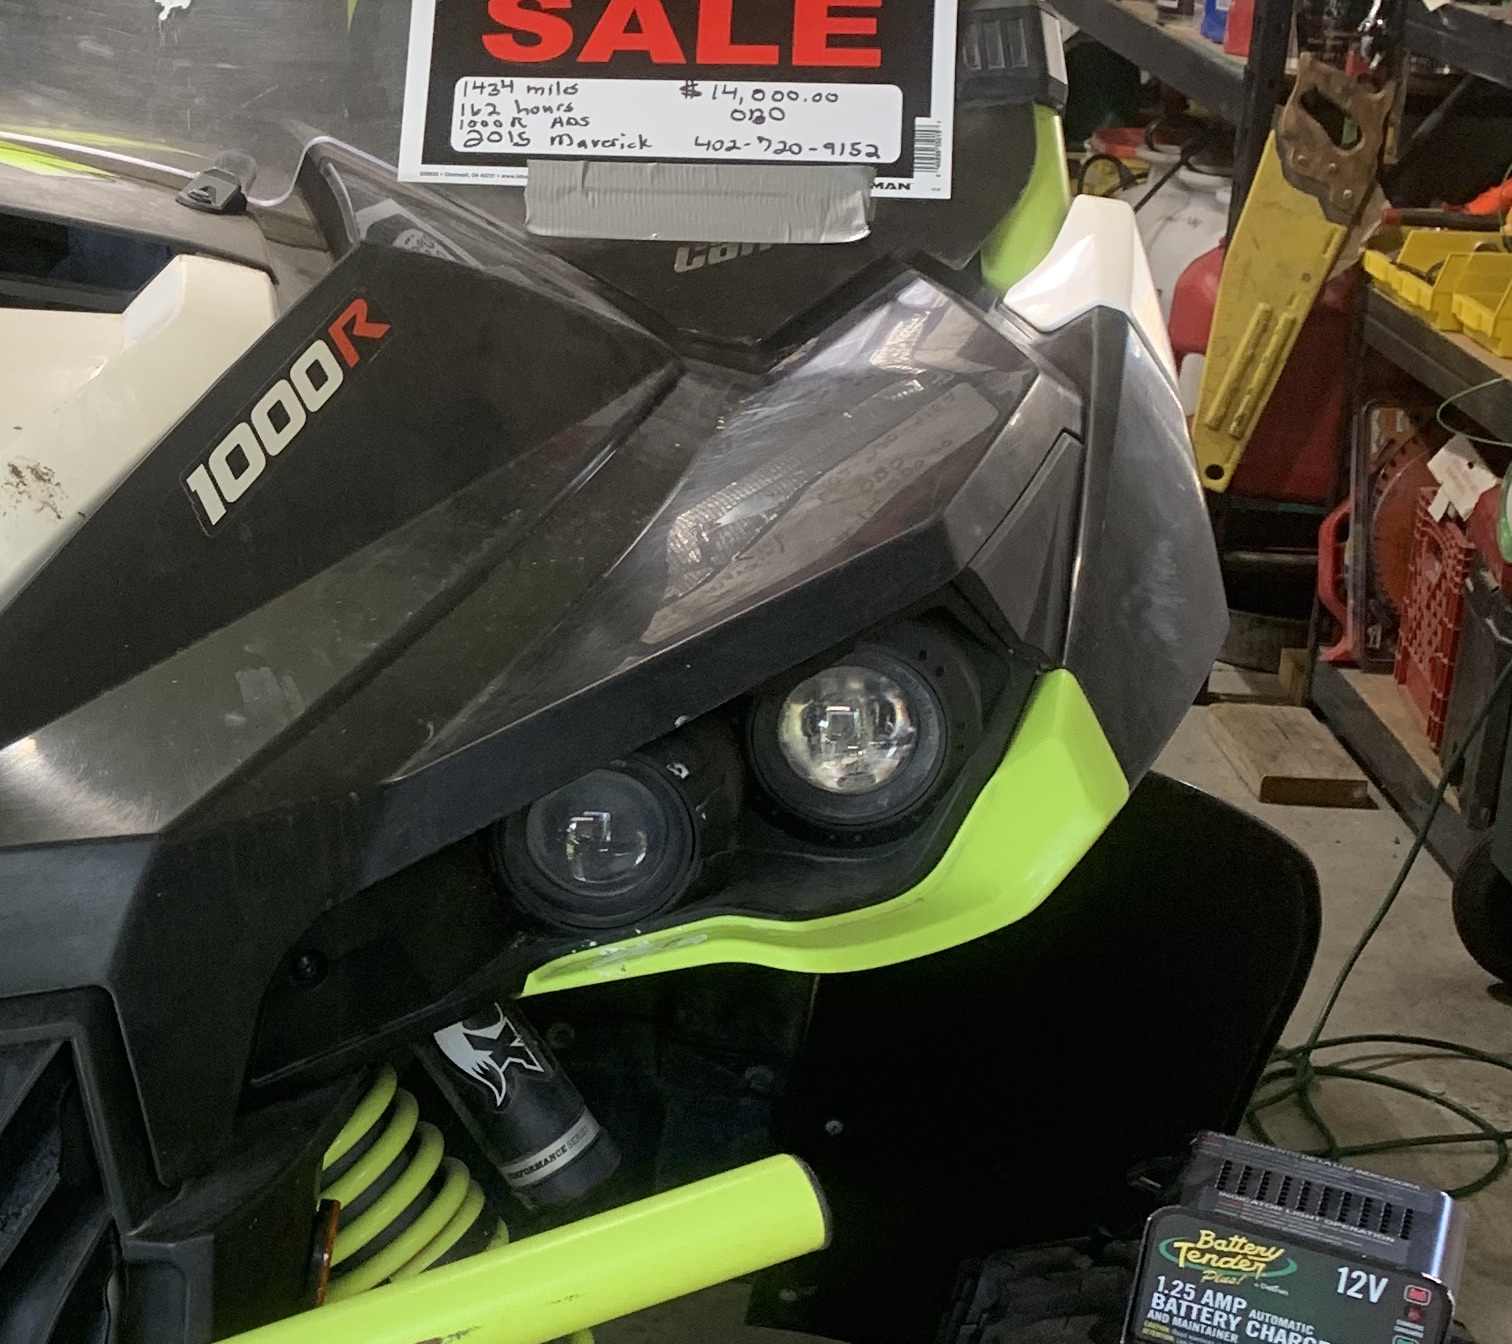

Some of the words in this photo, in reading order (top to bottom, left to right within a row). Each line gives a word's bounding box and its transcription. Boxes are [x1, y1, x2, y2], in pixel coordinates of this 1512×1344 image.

[462, 80, 514, 97] 1434
[460, 102, 501, 117] 162
[514, 99, 575, 116] hours
[463, 129, 531, 149] 2015
[694, 136, 881, 159] 402-720-9152
[186, 298, 392, 526] 1000R
[1173, 1242, 1267, 1280] Tender
[1195, 1229, 1285, 1262] Battery
[1157, 1275, 1198, 1301] 1.25
[1200, 1289, 1248, 1314] AMP
[1337, 1265, 1389, 1304] 12V
[1146, 1309, 1170, 1325] AND
[1171, 1316, 1238, 1344] MAINTAINER
[1150, 1292, 1242, 1333] BATTERY
[1248, 1309, 1315, 1336] AUTOMATIC
